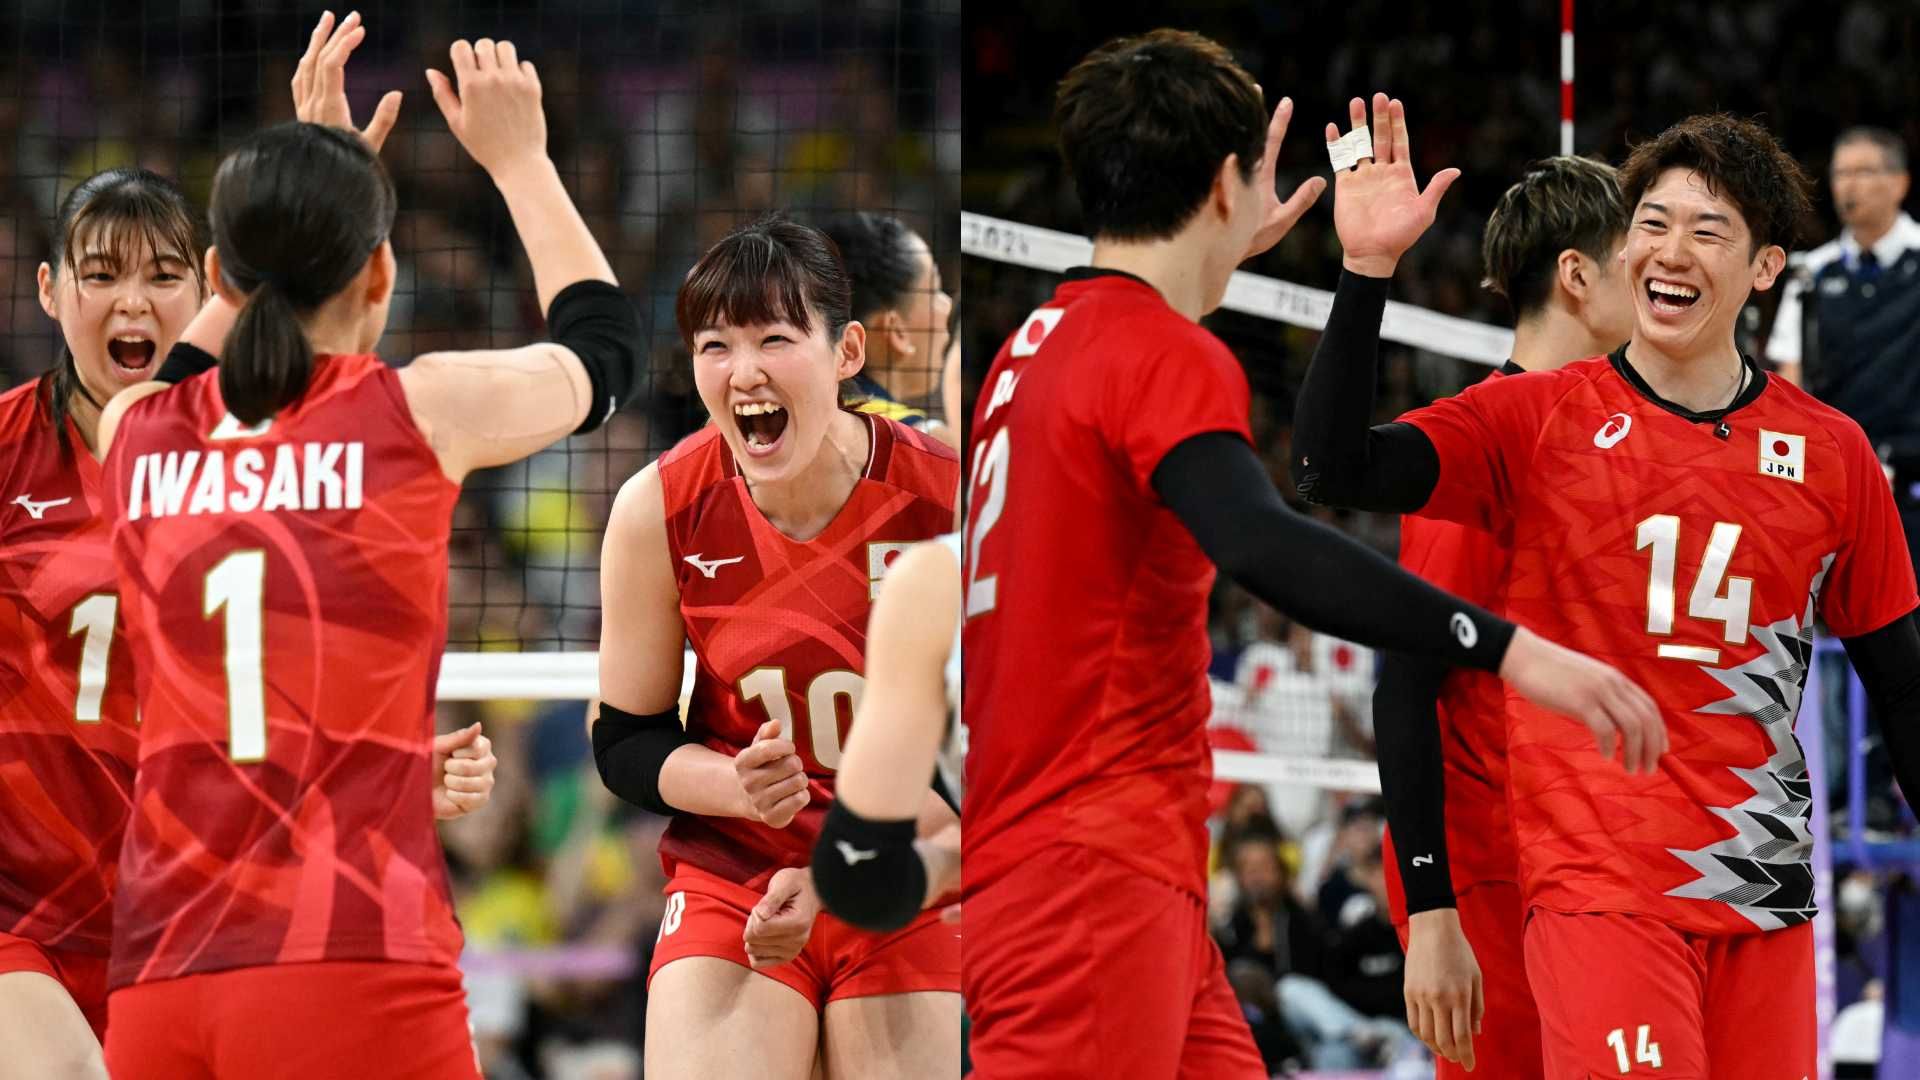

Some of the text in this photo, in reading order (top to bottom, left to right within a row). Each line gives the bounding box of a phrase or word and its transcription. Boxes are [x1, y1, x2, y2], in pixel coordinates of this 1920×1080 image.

[967, 221, 1030, 256] 2024
[128, 442, 364, 520] IWASAKI
[1766, 462, 1795, 478] JPN
[1635, 513, 1754, 645] 14
[204, 549, 266, 763] 1
[738, 665, 867, 771] 10
[1605, 1023, 1663, 1074] 14
